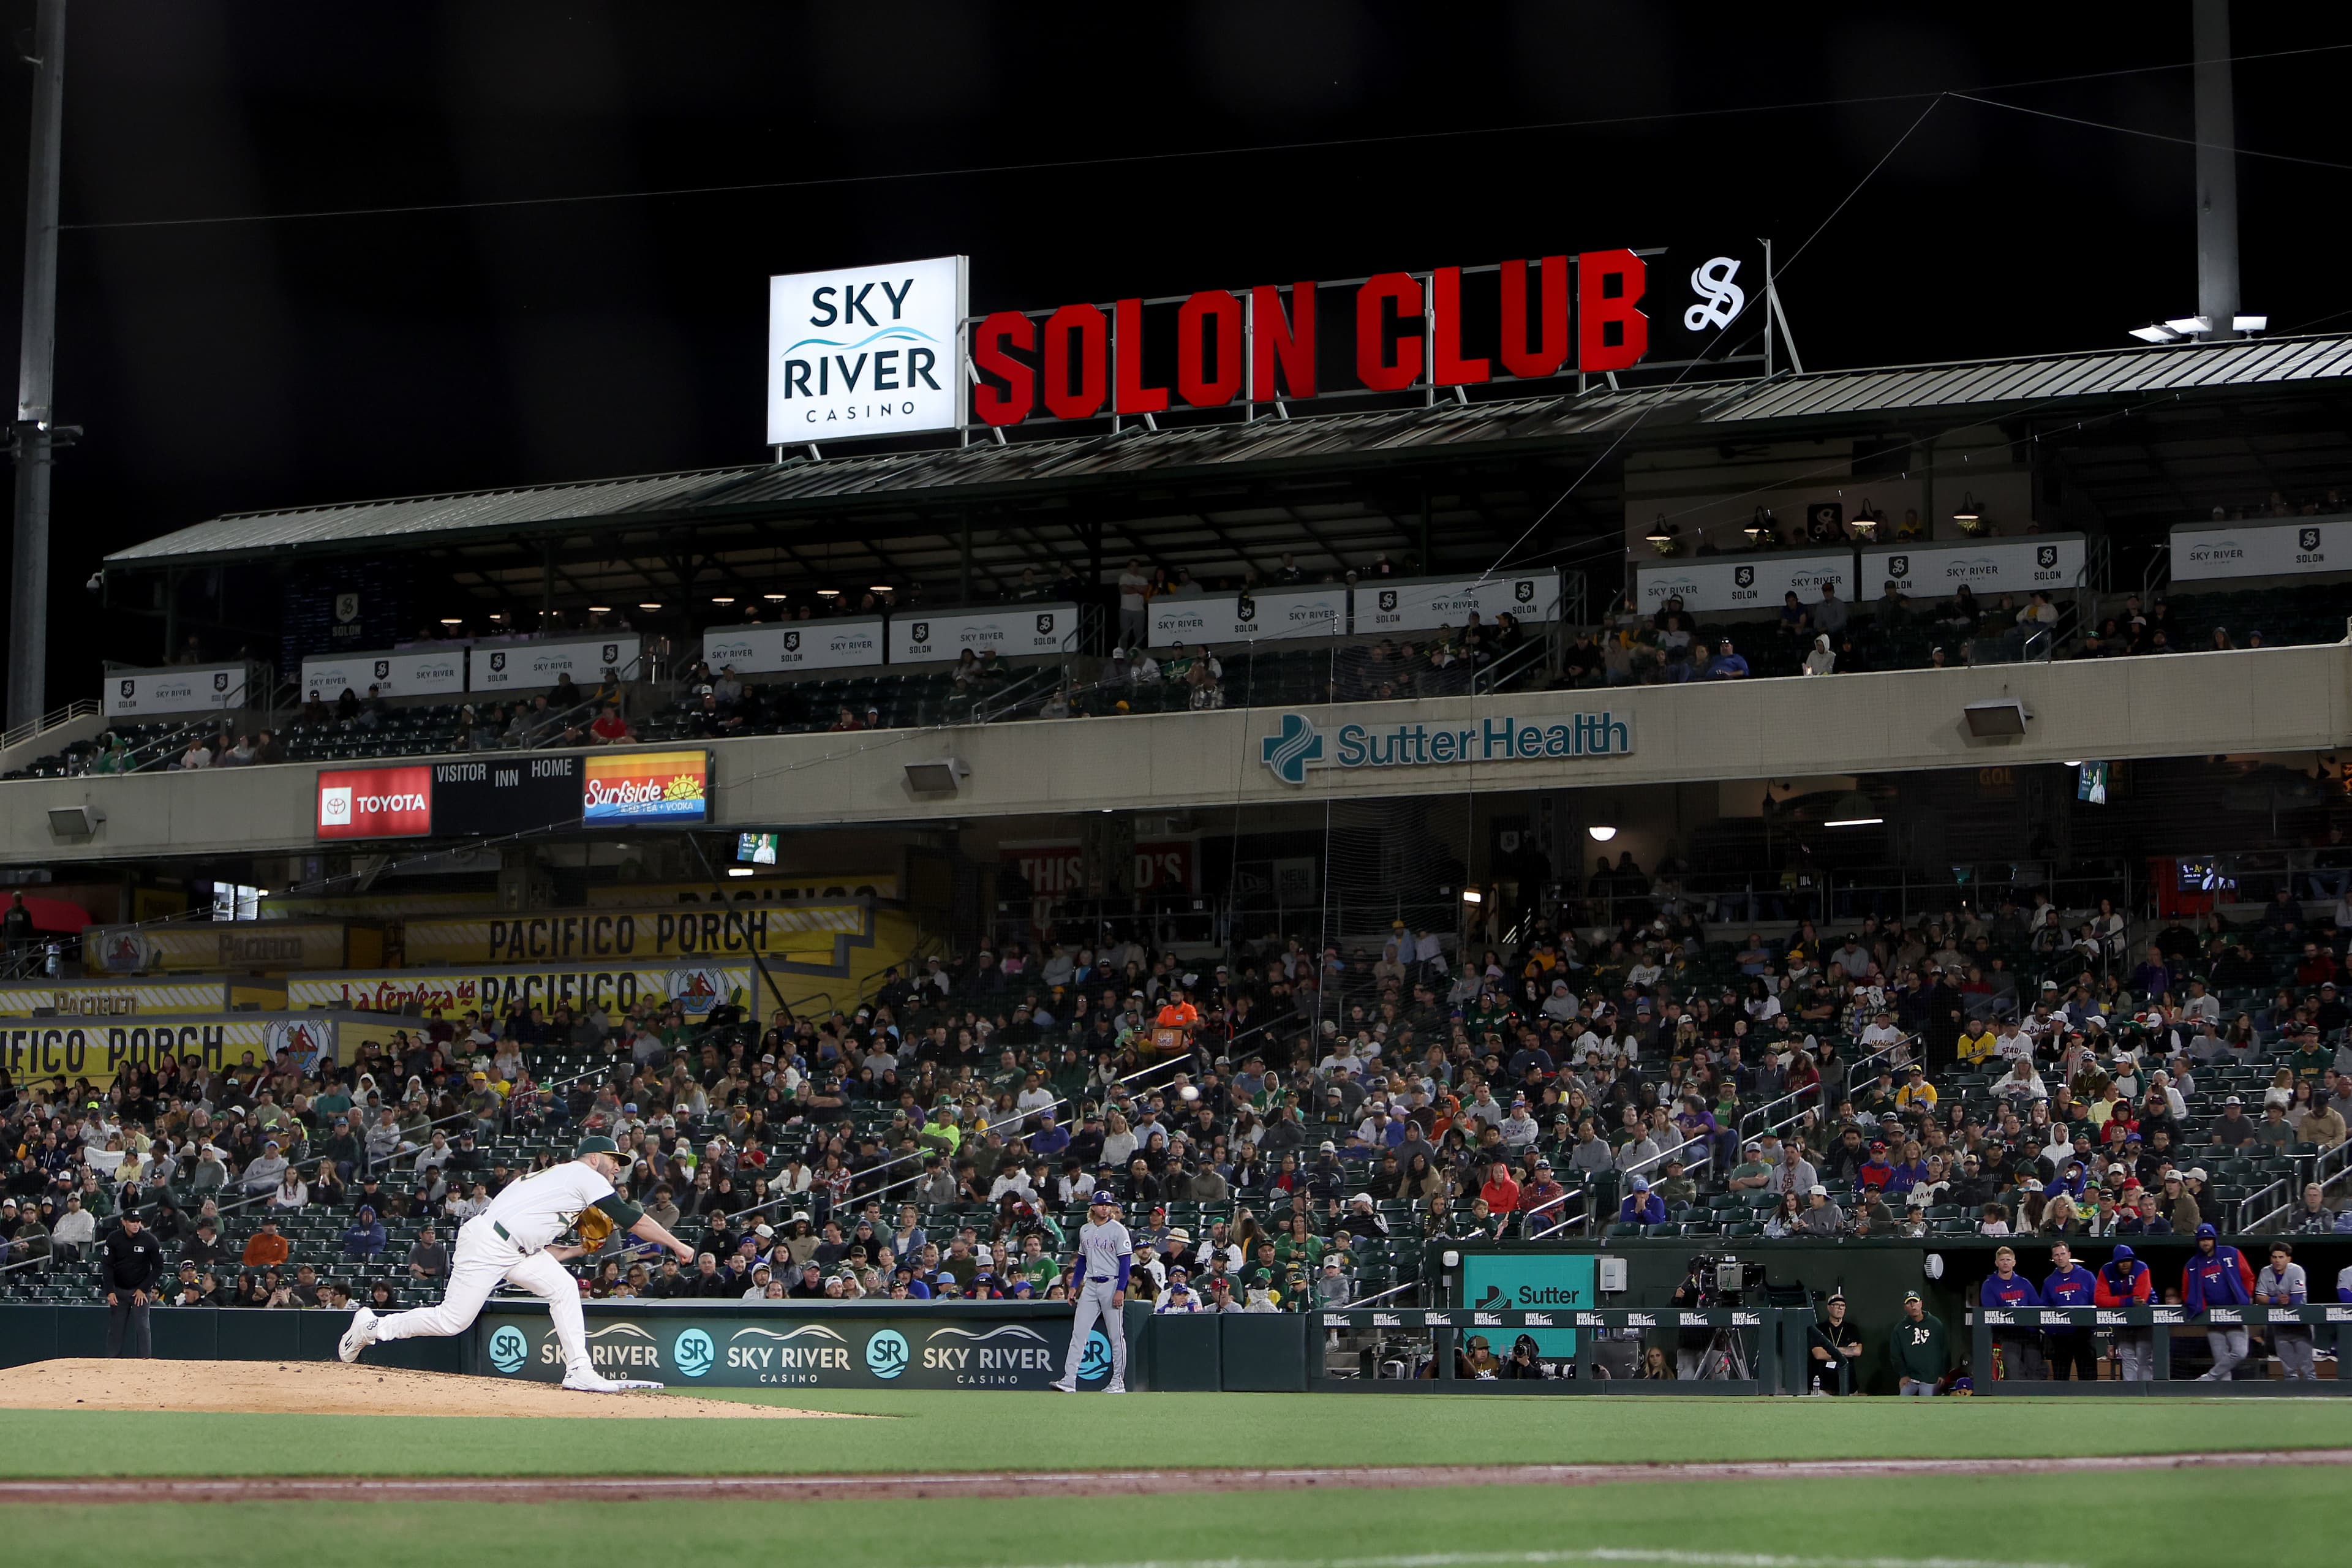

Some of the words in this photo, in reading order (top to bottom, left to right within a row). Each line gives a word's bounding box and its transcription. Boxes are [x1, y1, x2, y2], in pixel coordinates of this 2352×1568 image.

[809, 278, 914, 328] SKY
[974, 281, 1316, 427] SOLON
[1356, 248, 1649, 391] CLUB
[784, 347, 942, 399] RIVER
[806, 401, 915, 423] CASINO
[2190, 552, 2210, 561] SKY
[2214, 549, 2244, 559] RIVER
[2296, 553, 2324, 564] SOLON
[1947, 568, 1967, 578] SKY
[1969, 565, 1999, 576] RIVER
[2034, 570, 2061, 581] SOLON
[1791, 578, 1811, 587] SKY
[1814, 576, 1842, 586] RIVER
[1896, 580, 1912, 589] LON
[1648, 587, 1667, 597] SKY
[1670, 586, 1698, 595] RIVER
[1732, 590, 1758, 600] SOLON
[1432, 602, 1450, 611] SKY
[1453, 600, 1480, 609] RIVER
[1512, 605, 1537, 614] SOLON
[1289, 611, 1307, 620] SKY
[1310, 609, 1335, 619] RIVER
[1376, 614, 1401, 624] SOLON
[1158, 620, 1176, 630] SKY
[1178, 619, 1204, 628] RIVER
[1234, 624, 1258, 633] SOLON
[333, 625, 361, 637] SOLON
[979, 632, 1004, 641] RIVER
[848, 641, 873, 649] RIVER
[1033, 636, 1057, 646] SOLON
[729, 649, 753, 658] RIVER
[909, 646, 931, 654] SOLON
[781, 654, 802, 663] SOLON
[432, 669, 454, 678] RIVER
[326, 677, 347, 685] RIVER
[156, 691, 169, 699] SKY
[170, 688, 192, 698] RIVER
[118, 700, 137, 709] SOLON
[1336, 725, 1476, 767] Sutter
[1482, 712, 1629, 760] Health
[437, 763, 487, 783] VISITOR
[531, 759, 572, 778] HOME
[495, 769, 519, 788] INN
[584, 778, 662, 809] Surfside
[357, 794, 426, 813] TOYOTA
[621, 805, 639, 813] ICED
[642, 804, 657, 812] TEA
[666, 802, 693, 811] VODKA
[1019, 857, 1084, 892] THIS
[1800, 875, 1811, 887] 104
[490, 915, 635, 959] PACIFICO
[657, 911, 767, 953] PORCH
[219, 935, 303, 965] PACIFICO
[375, 981, 454, 1011] Cerveza
[481, 972, 637, 1017] PACIFICO
[54, 991, 138, 1016] PACIFICO
[108, 1026, 223, 1073] PORCH
[1082, 1235, 1116, 1251] TEXAS
[2223, 1257, 2233, 1268] T
[2211, 1275, 2217, 1283] T
[1519, 1286, 1580, 1305] Sutter
[2064, 1292, 2071, 1301] T
[1911, 1327, 1931, 1346] A's
[495, 1335, 521, 1360] SR
[680, 1337, 708, 1362] SR
[873, 1339, 902, 1362] SR
[541, 1344, 567, 1365] SK
[592, 1346, 660, 1368] RIVER
[727, 1348, 774, 1370] SKY
[782, 1348, 851, 1371] RIVER
[922, 1348, 973, 1371] SKY
[980, 1348, 1053, 1372] RIVER
[603, 1371, 627, 1380] INO
[760, 1374, 818, 1384] CASINO
[957, 1374, 1018, 1384] CASINO
